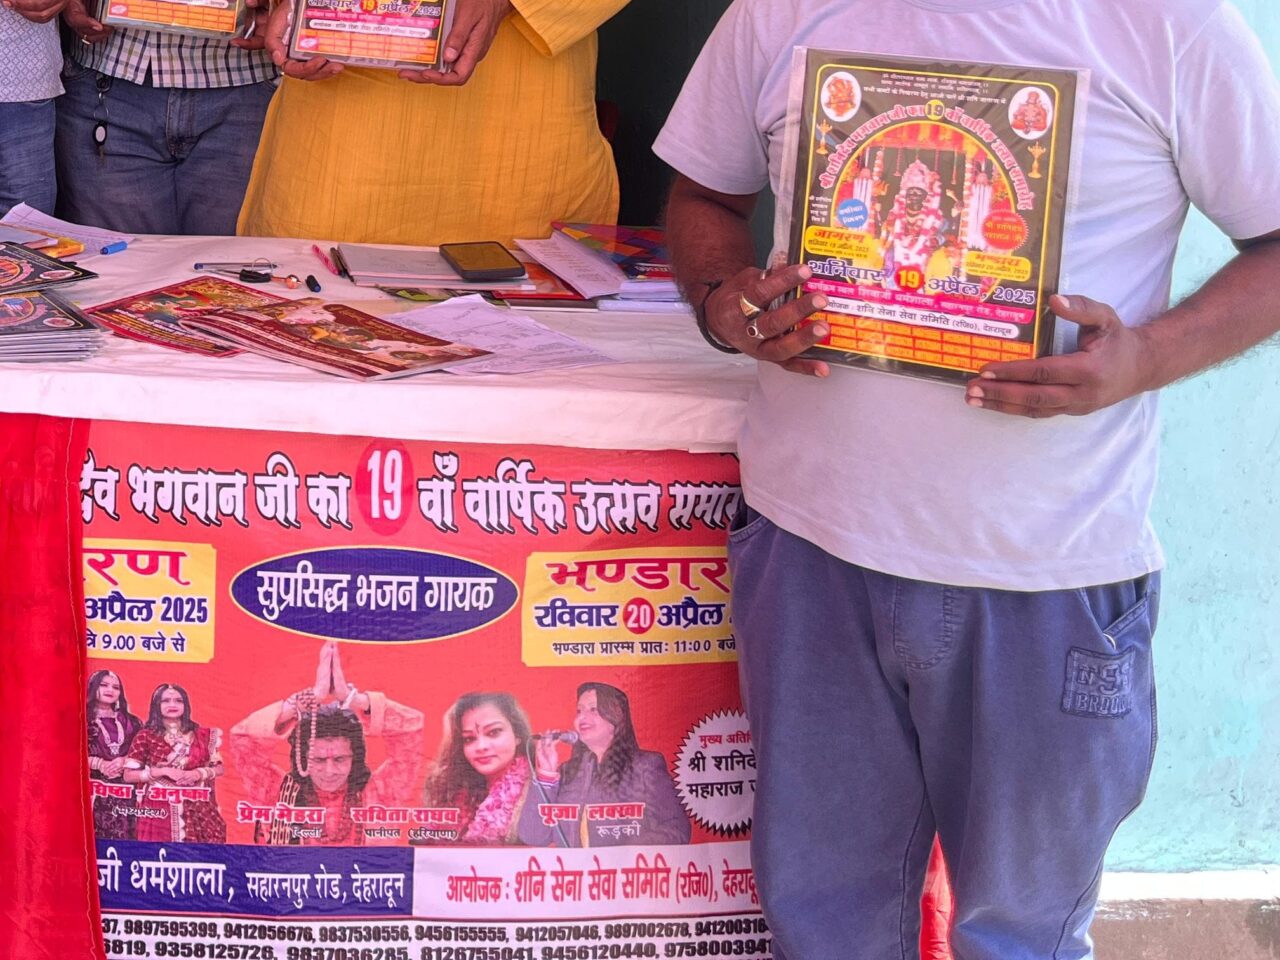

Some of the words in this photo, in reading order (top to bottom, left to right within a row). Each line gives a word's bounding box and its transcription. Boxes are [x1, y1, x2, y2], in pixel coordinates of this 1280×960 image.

[363, 0, 375, 10] 19
[927, 103, 943, 117] 19
[808, 258, 887, 281] शनिवार
[898, 270, 920, 288] 19
[993, 286, 1035, 305] 2025
[127, 463, 249, 527] भगवान
[254, 451, 301, 529] जी
[306, 471, 353, 530] का
[367, 449, 403, 520] 19
[461, 457, 566, 534] वार्षिक
[571, 478, 662, 534] उत्सव
[668, 480, 741, 530] समार
[82, 548, 191, 586] रण
[546, 558, 730, 593] भण्डार
[256, 560, 351, 620] सुप्रसिद्ध
[356, 574, 419, 611] भजन
[424, 576, 497, 611] गायक
[85, 591, 156, 623] अप्रैल
[160, 597, 208, 623] 2025
[534, 597, 619, 628] रविवार
[626, 604, 651, 628] 20
[657, 597, 726, 628] अप्रैल
[102, 634, 136, 651] 9.00
[140, 631, 166, 651] बजे
[170, 632, 186, 652] से
[553, 641, 595, 655] भण्डारा
[675, 640, 711, 652] 11:00
[699, 734, 723, 749] मुख्य
[726, 730, 752, 744] अति
[688, 751, 706, 772] श्री
[712, 748, 757, 771] शनिदे
[686, 781, 744, 799] महाराज
[237, 801, 273, 822] प्रेम
[350, 804, 410, 823] सविता
[412, 808, 460, 824] राघव
[538, 803, 580, 827] पूजा
[97, 847, 122, 893] जी
[130, 848, 235, 903] धर्मशाला,
[245, 871, 312, 909] सहारनपुर
[314, 864, 348, 904] रोड,
[350, 864, 406, 908] देहरादून
[446, 865, 503, 903] आयोजक
[514, 855, 546, 903] शनि
[550, 855, 584, 902] सेना
[587, 854, 617, 901] सेवा
[621, 852, 671, 900] समिति
[722, 858, 761, 905] देहरादू
[101, 918, 121, 936] 37,
[124, 919, 221, 940] 9897595399,
[223, 922, 316, 944] 9412056676,
[319, 925, 412, 943] 9837530556,
[414, 925, 509, 943] 9456155555,
[604, 921, 692, 939] 9897002678,
[104, 939, 150, 957] 6819,
